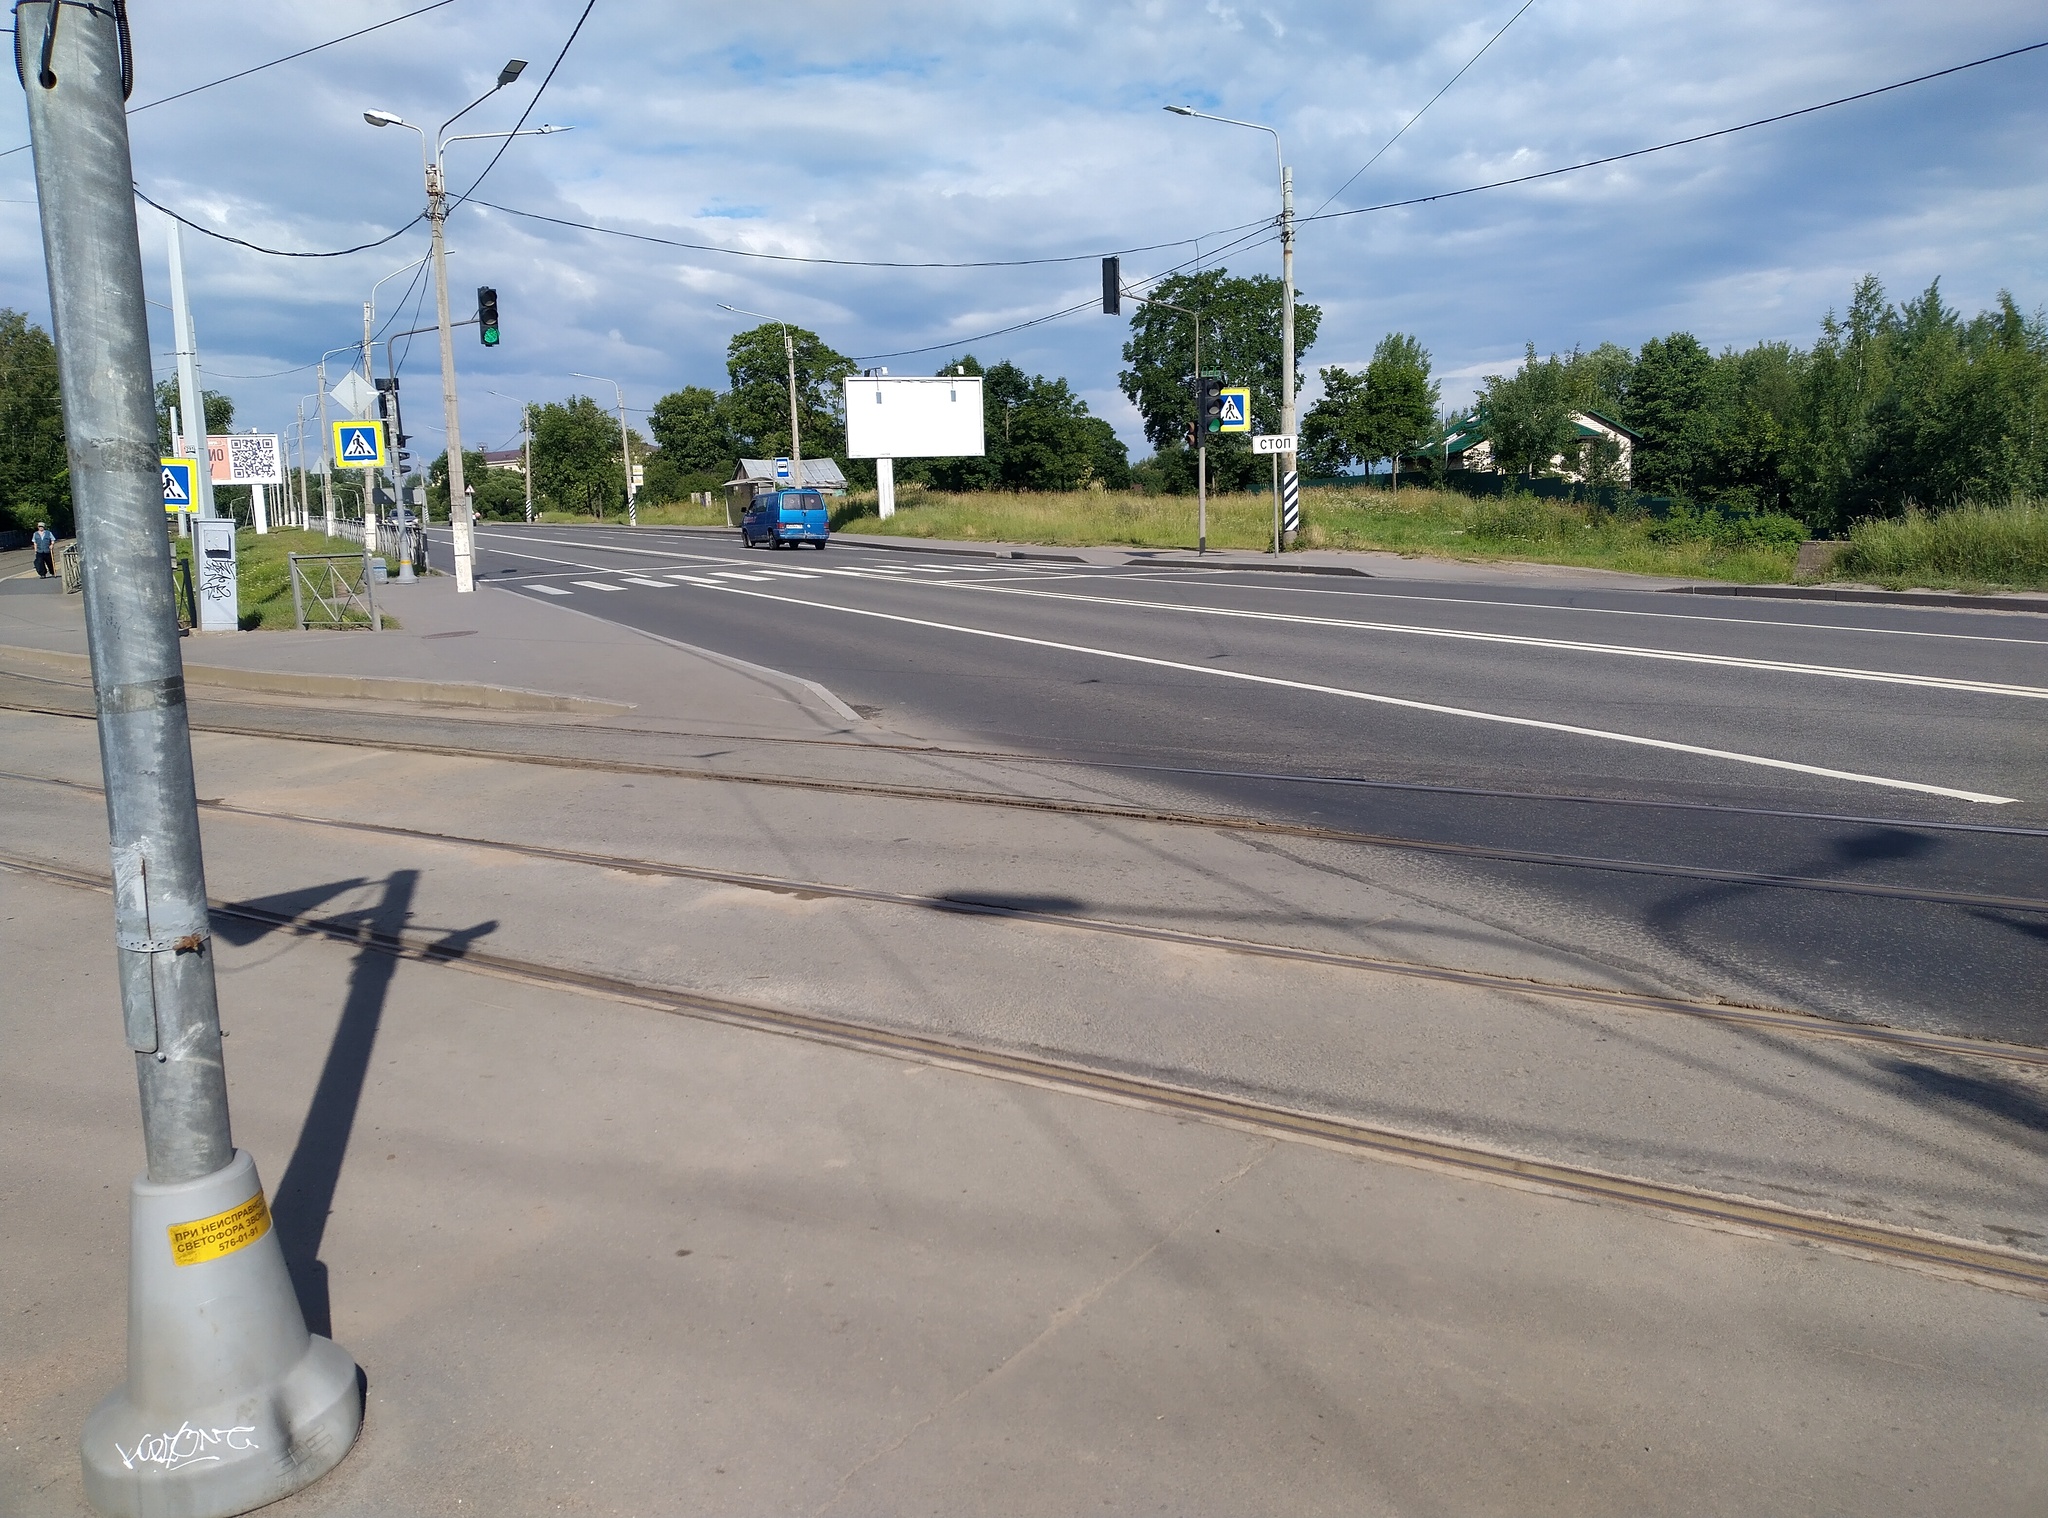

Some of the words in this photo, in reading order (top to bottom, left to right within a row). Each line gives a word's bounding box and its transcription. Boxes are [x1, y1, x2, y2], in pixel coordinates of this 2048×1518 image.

[1260, 438, 1291, 450] СТОП
[174, 1228, 199, 1242] ПРИ
[177, 1223, 245, 1253] СВЕТОФОРА
[218, 1226, 259, 1252] 576-01-91
